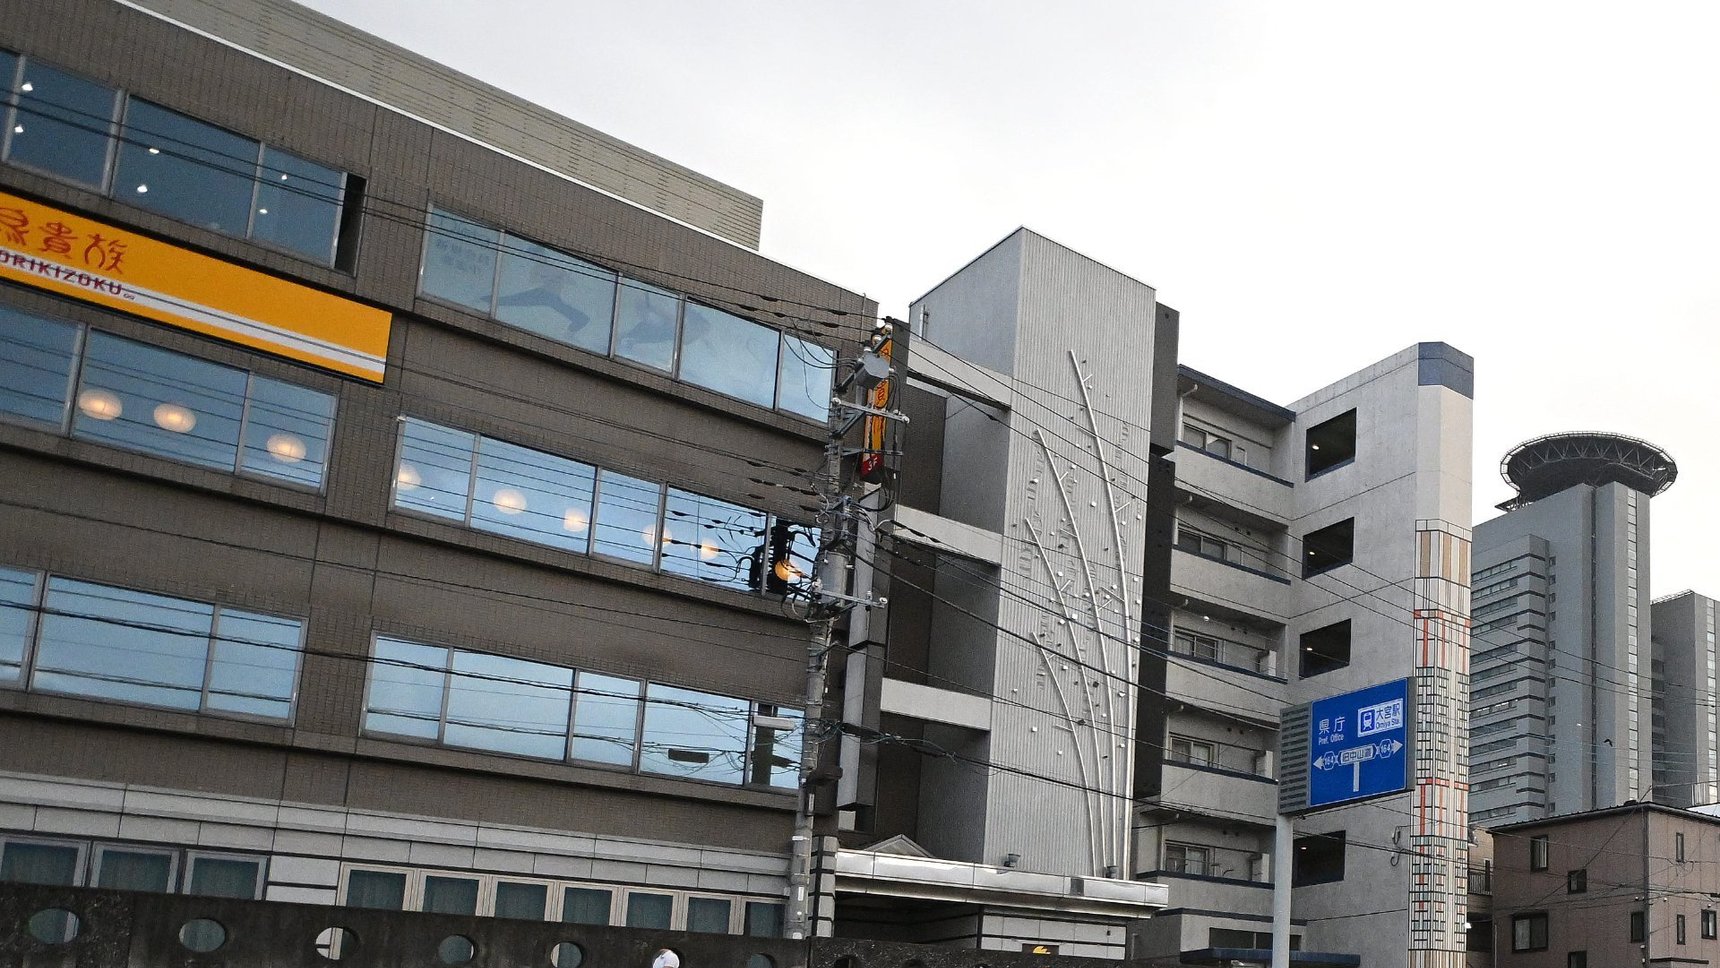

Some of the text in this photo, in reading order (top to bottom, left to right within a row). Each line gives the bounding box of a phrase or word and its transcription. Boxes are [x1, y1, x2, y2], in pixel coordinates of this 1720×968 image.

[1376, 703, 1400, 720] 大宮駅
[1318, 716, 1346, 735] 県庁
